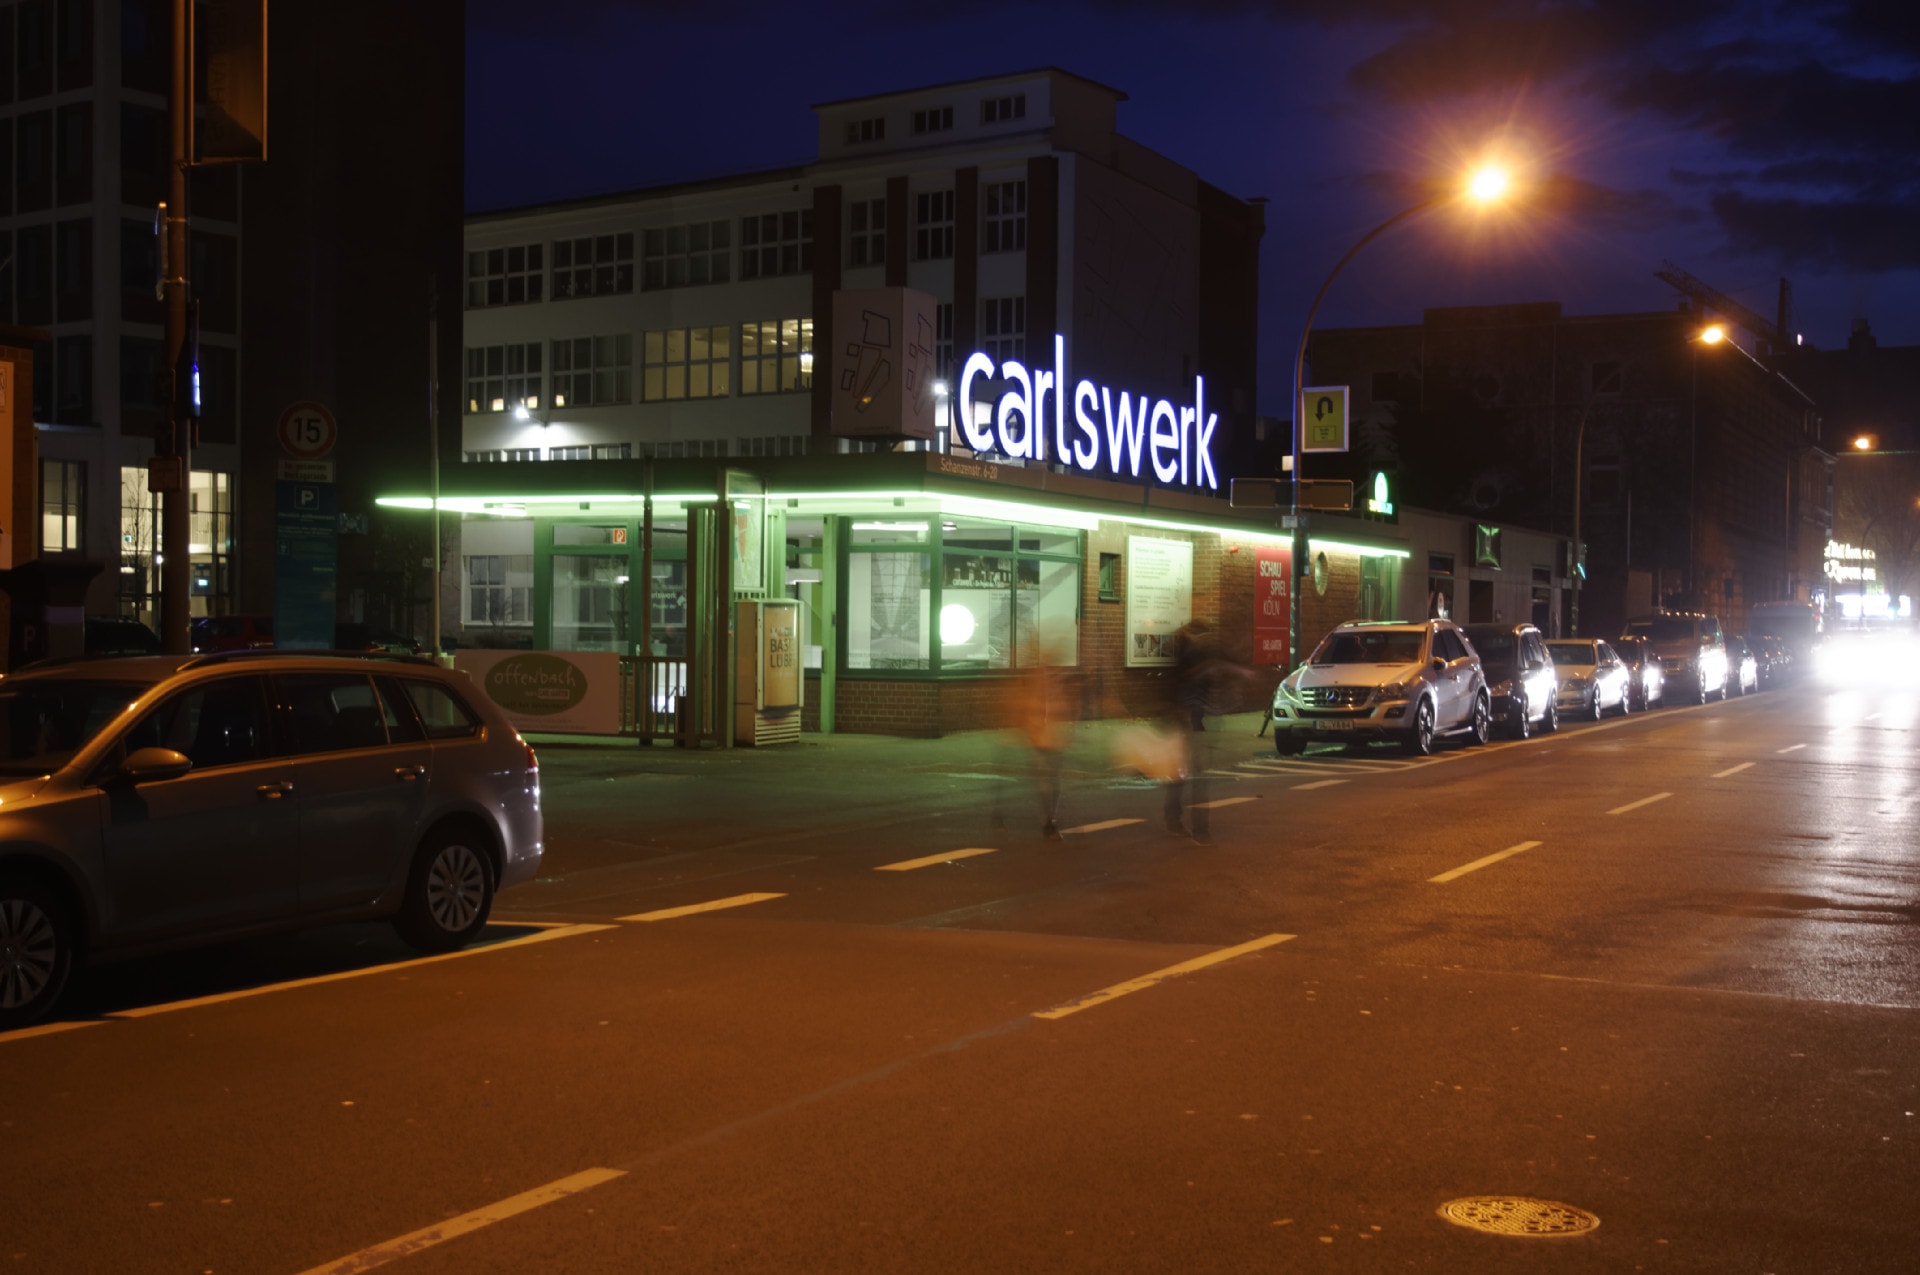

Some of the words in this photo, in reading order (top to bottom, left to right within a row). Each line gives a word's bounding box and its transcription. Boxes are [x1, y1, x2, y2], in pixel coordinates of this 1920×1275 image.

[960, 334, 1218, 489] carlswerk
[294, 417, 321, 443] 15
[940, 457, 982, 478] Schanzenstr.
[983, 464, 998, 480] 6-20
[301, 489, 314, 505] P
[1259, 560, 1282, 578] SCHAU
[1270, 579, 1287, 597] SPIEL
[1263, 596, 1280, 616] KÖLN
